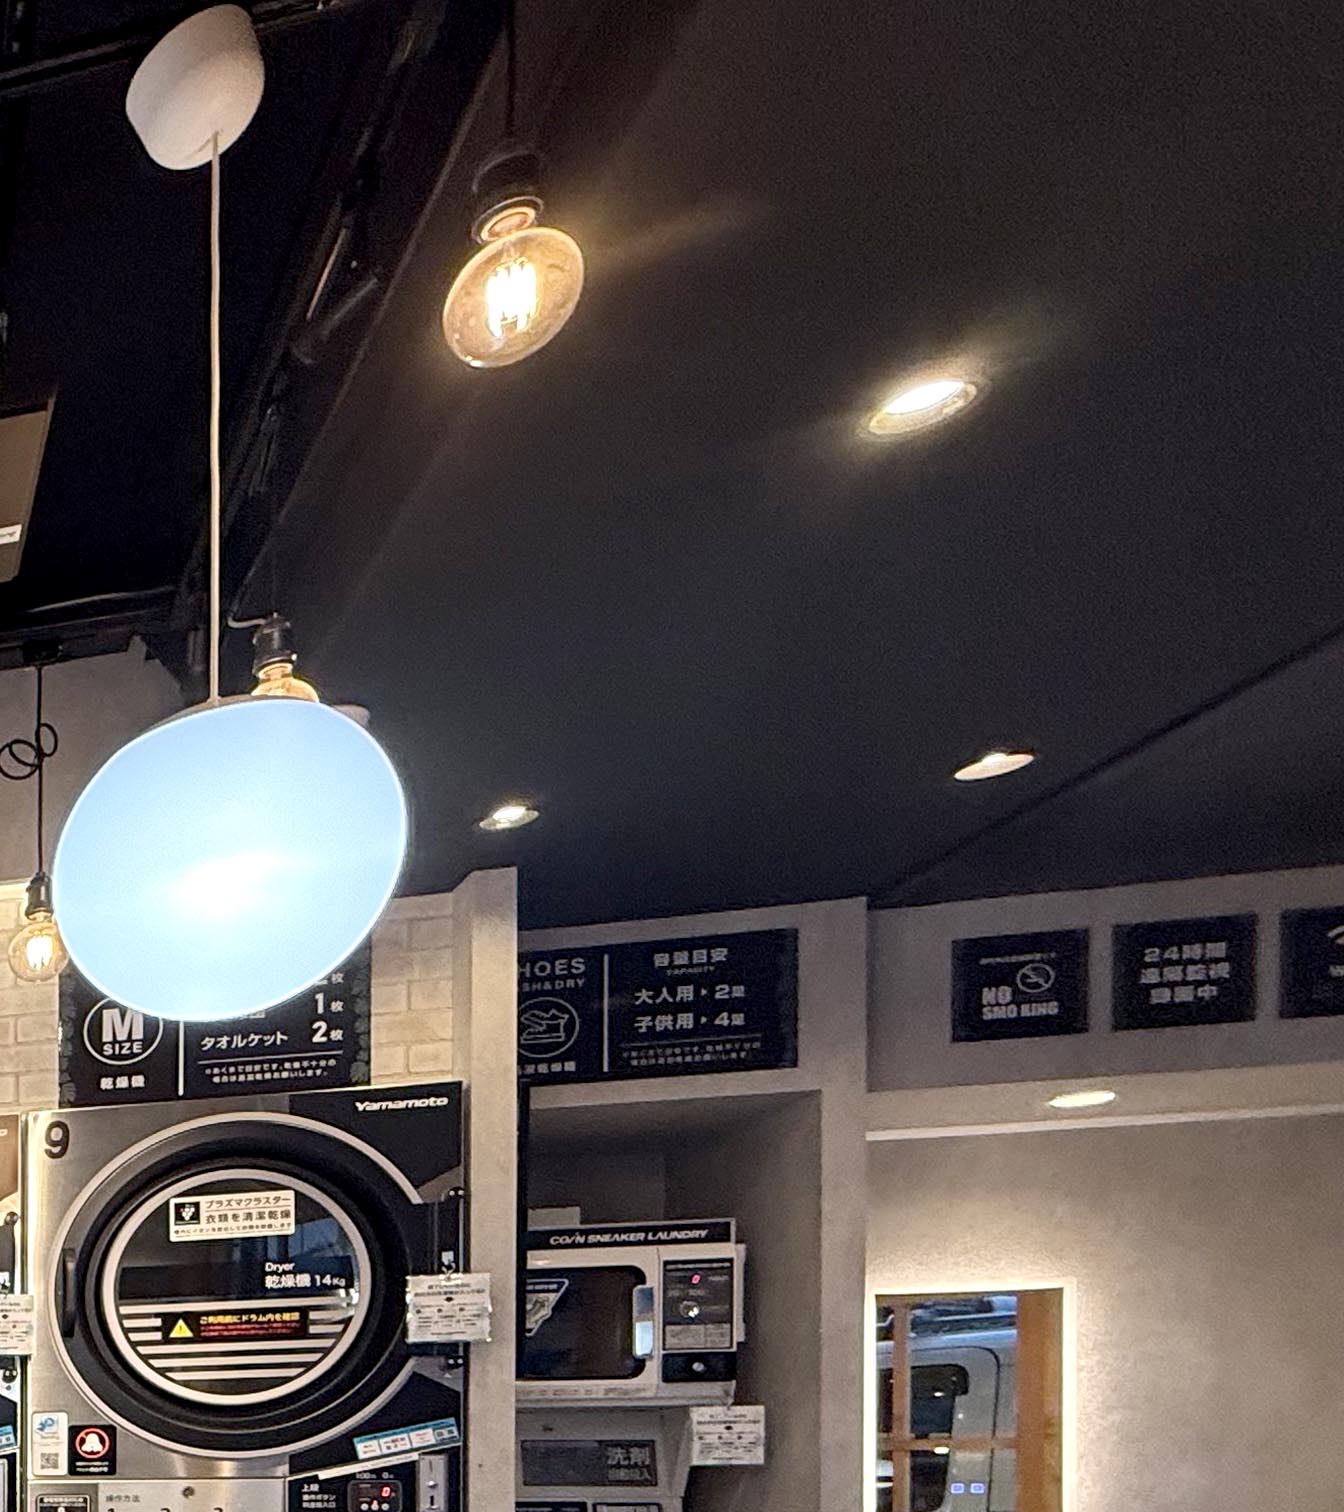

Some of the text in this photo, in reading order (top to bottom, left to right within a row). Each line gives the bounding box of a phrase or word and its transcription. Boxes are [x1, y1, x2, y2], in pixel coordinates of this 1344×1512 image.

[634, 984, 695, 1006] 大人用
[981, 985, 1013, 1006] NO
[101, 1007, 145, 1043] M
[634, 1012, 695, 1034] 子供用
[102, 1041, 143, 1057] SIZE
[199, 1031, 289, 1052] タオルケット
[354, 1095, 449, 1112] Yamamoto
[43, 1120, 71, 1159] 9
[587, 1231, 646, 1244] SNEAKER
[647, 1228, 709, 1242] LAUNDRY
[264, 1261, 295, 1274] Dryer
